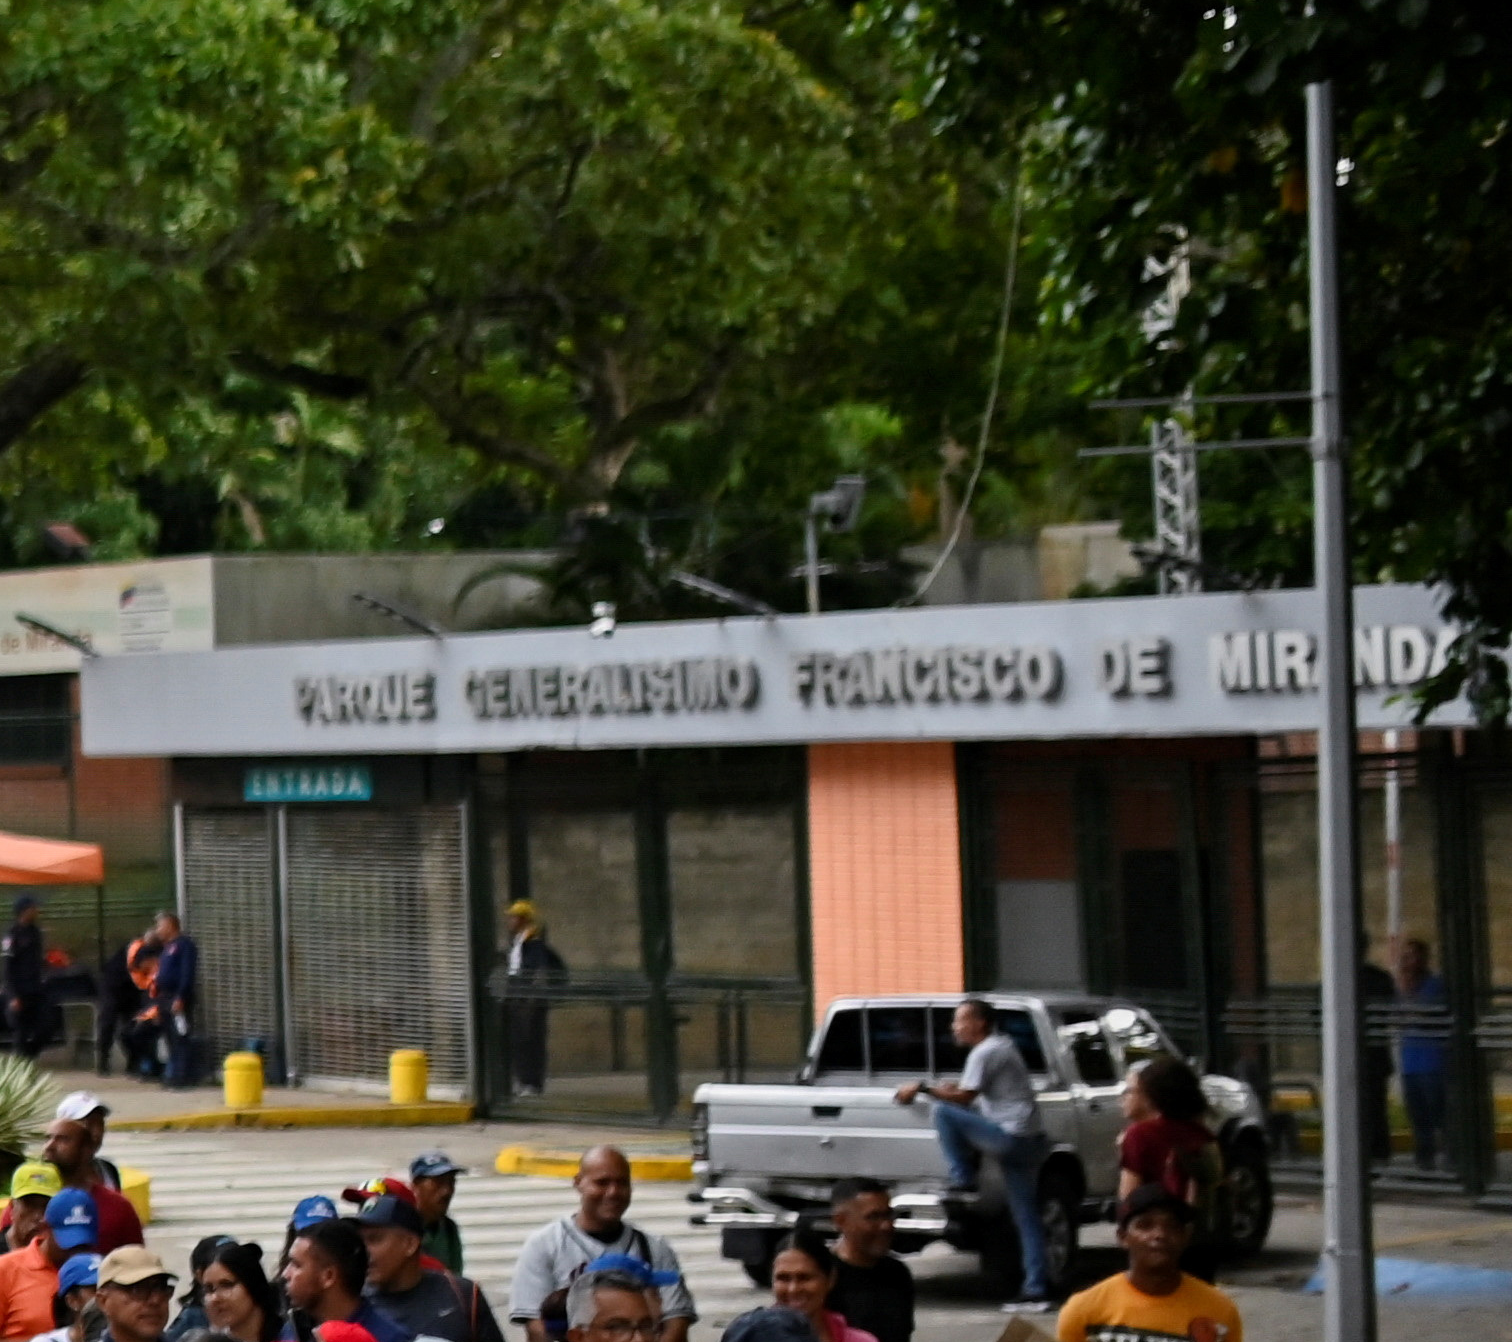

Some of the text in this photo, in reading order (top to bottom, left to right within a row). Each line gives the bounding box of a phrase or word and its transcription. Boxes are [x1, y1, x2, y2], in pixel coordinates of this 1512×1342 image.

[295, 672, 437, 723] PARQUE
[791, 646, 1064, 706] FRANCISCO
[1100, 637, 1170, 699] DE
[1210, 624, 1462, 693] MIRND
[252, 768, 363, 796] ENTRADA
